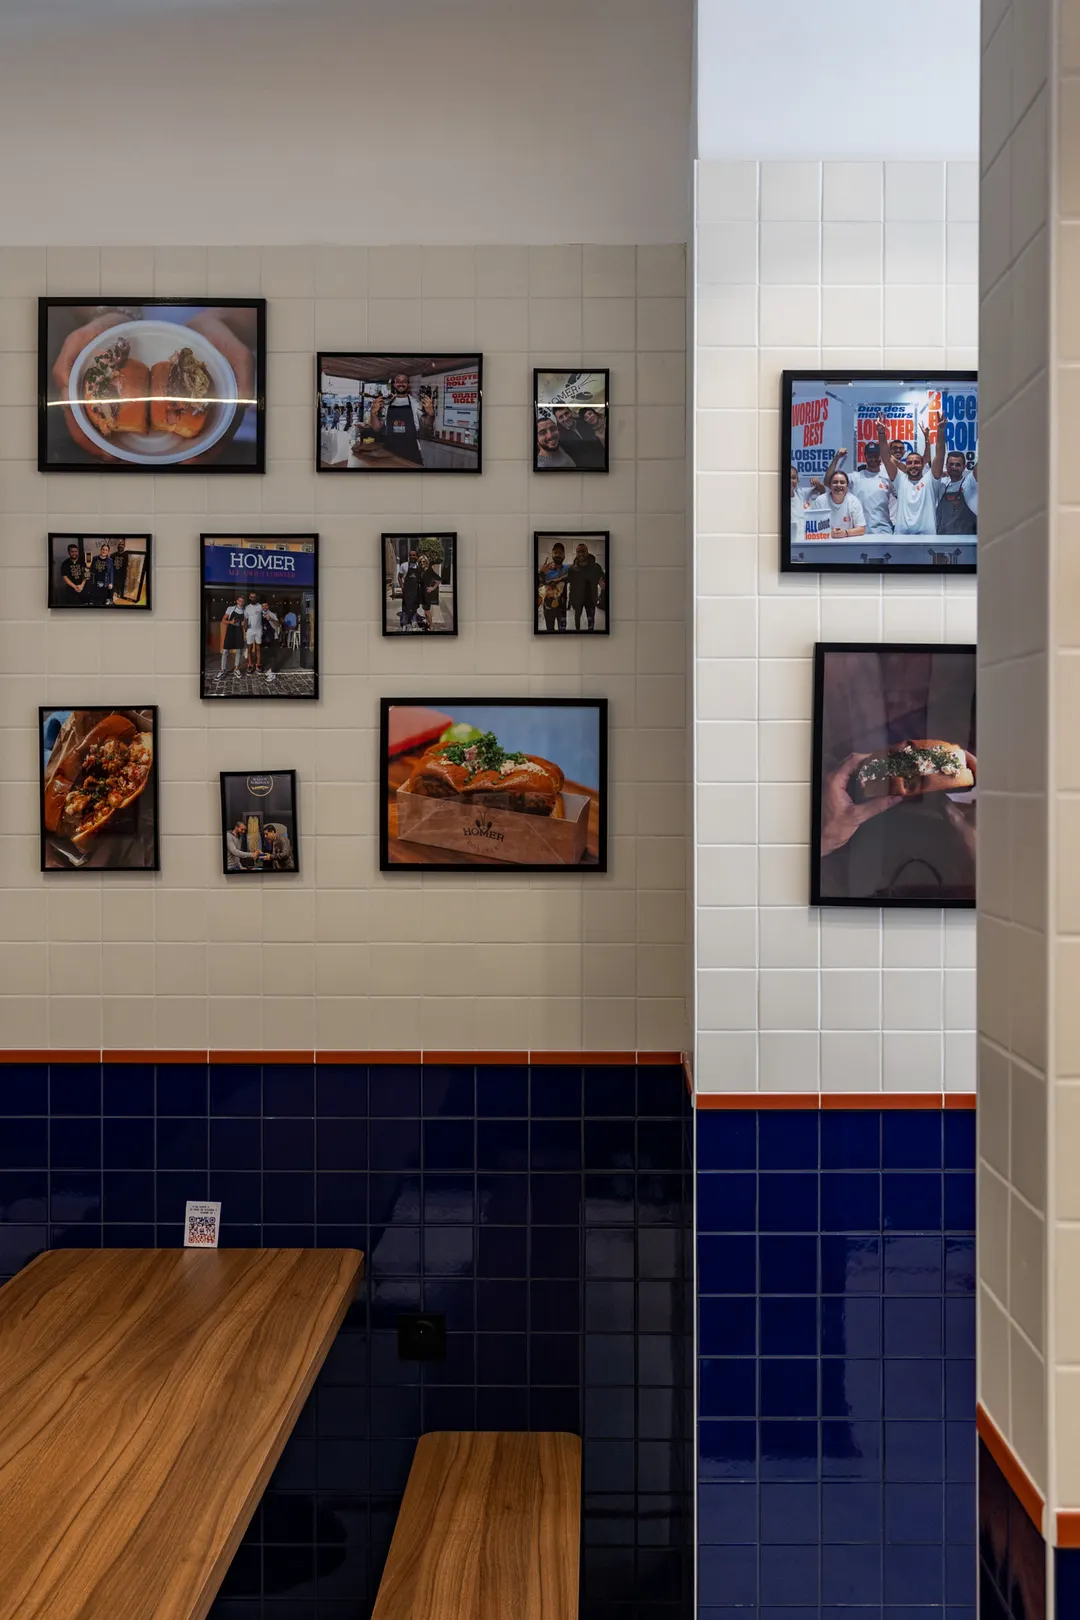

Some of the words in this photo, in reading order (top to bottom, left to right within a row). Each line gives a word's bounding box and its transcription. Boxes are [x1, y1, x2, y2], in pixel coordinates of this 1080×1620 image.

[791, 398, 829, 428] WORLD'S
[942, 391, 978, 421] bee
[803, 422, 824, 448] BEST
[944, 422, 978, 451] ROL
[797, 461, 829, 473] ROLLS
[805, 520, 818, 533] ALL
[805, 533, 830, 541] lobster
[229, 552, 296, 571] HOMER
[462, 827, 505, 843] HOMER
